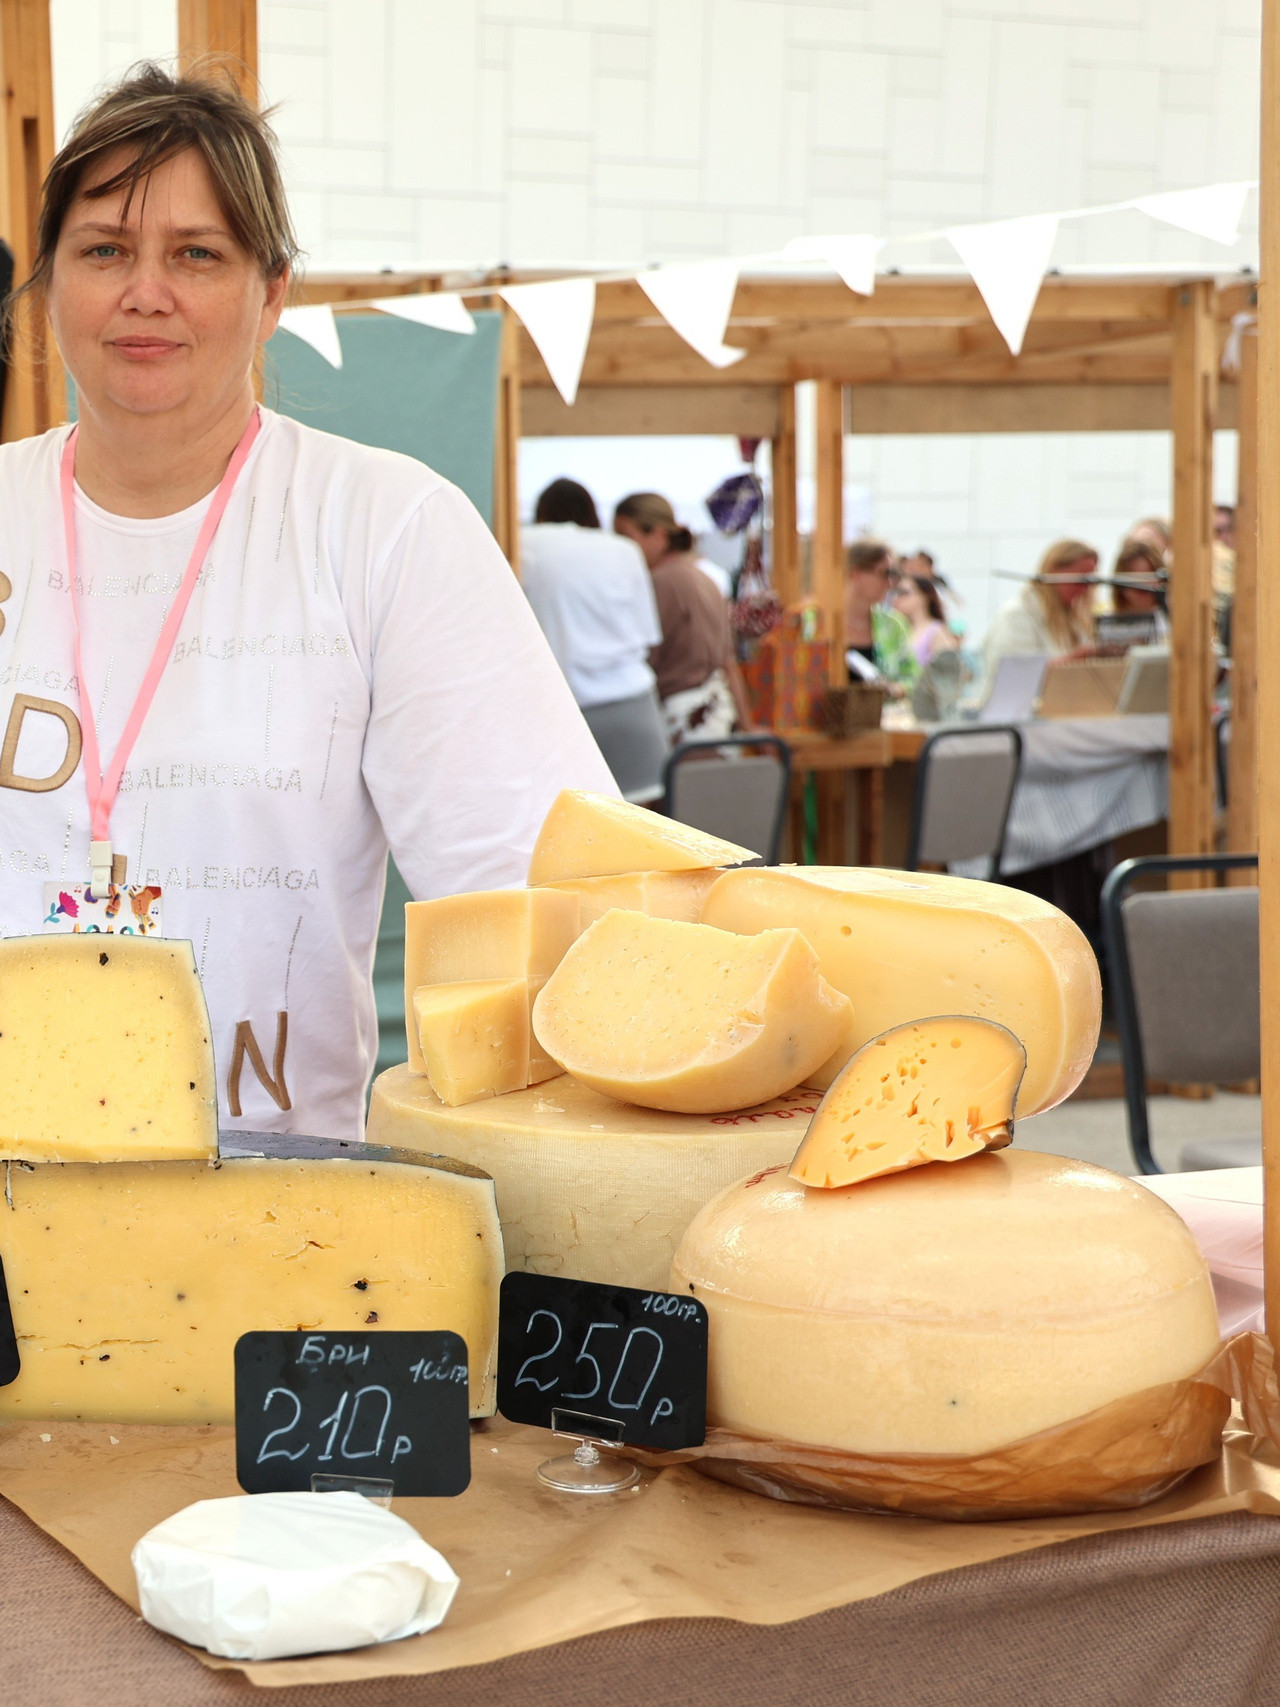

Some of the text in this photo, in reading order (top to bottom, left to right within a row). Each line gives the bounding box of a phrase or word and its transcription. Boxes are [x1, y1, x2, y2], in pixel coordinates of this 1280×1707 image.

[172, 632, 351, 665] BALENCIAGA
[118, 763, 302, 793] BALENCIAGA
[145, 866, 320, 891] BALENCIAGA
[227, 1010, 291, 1117] N
